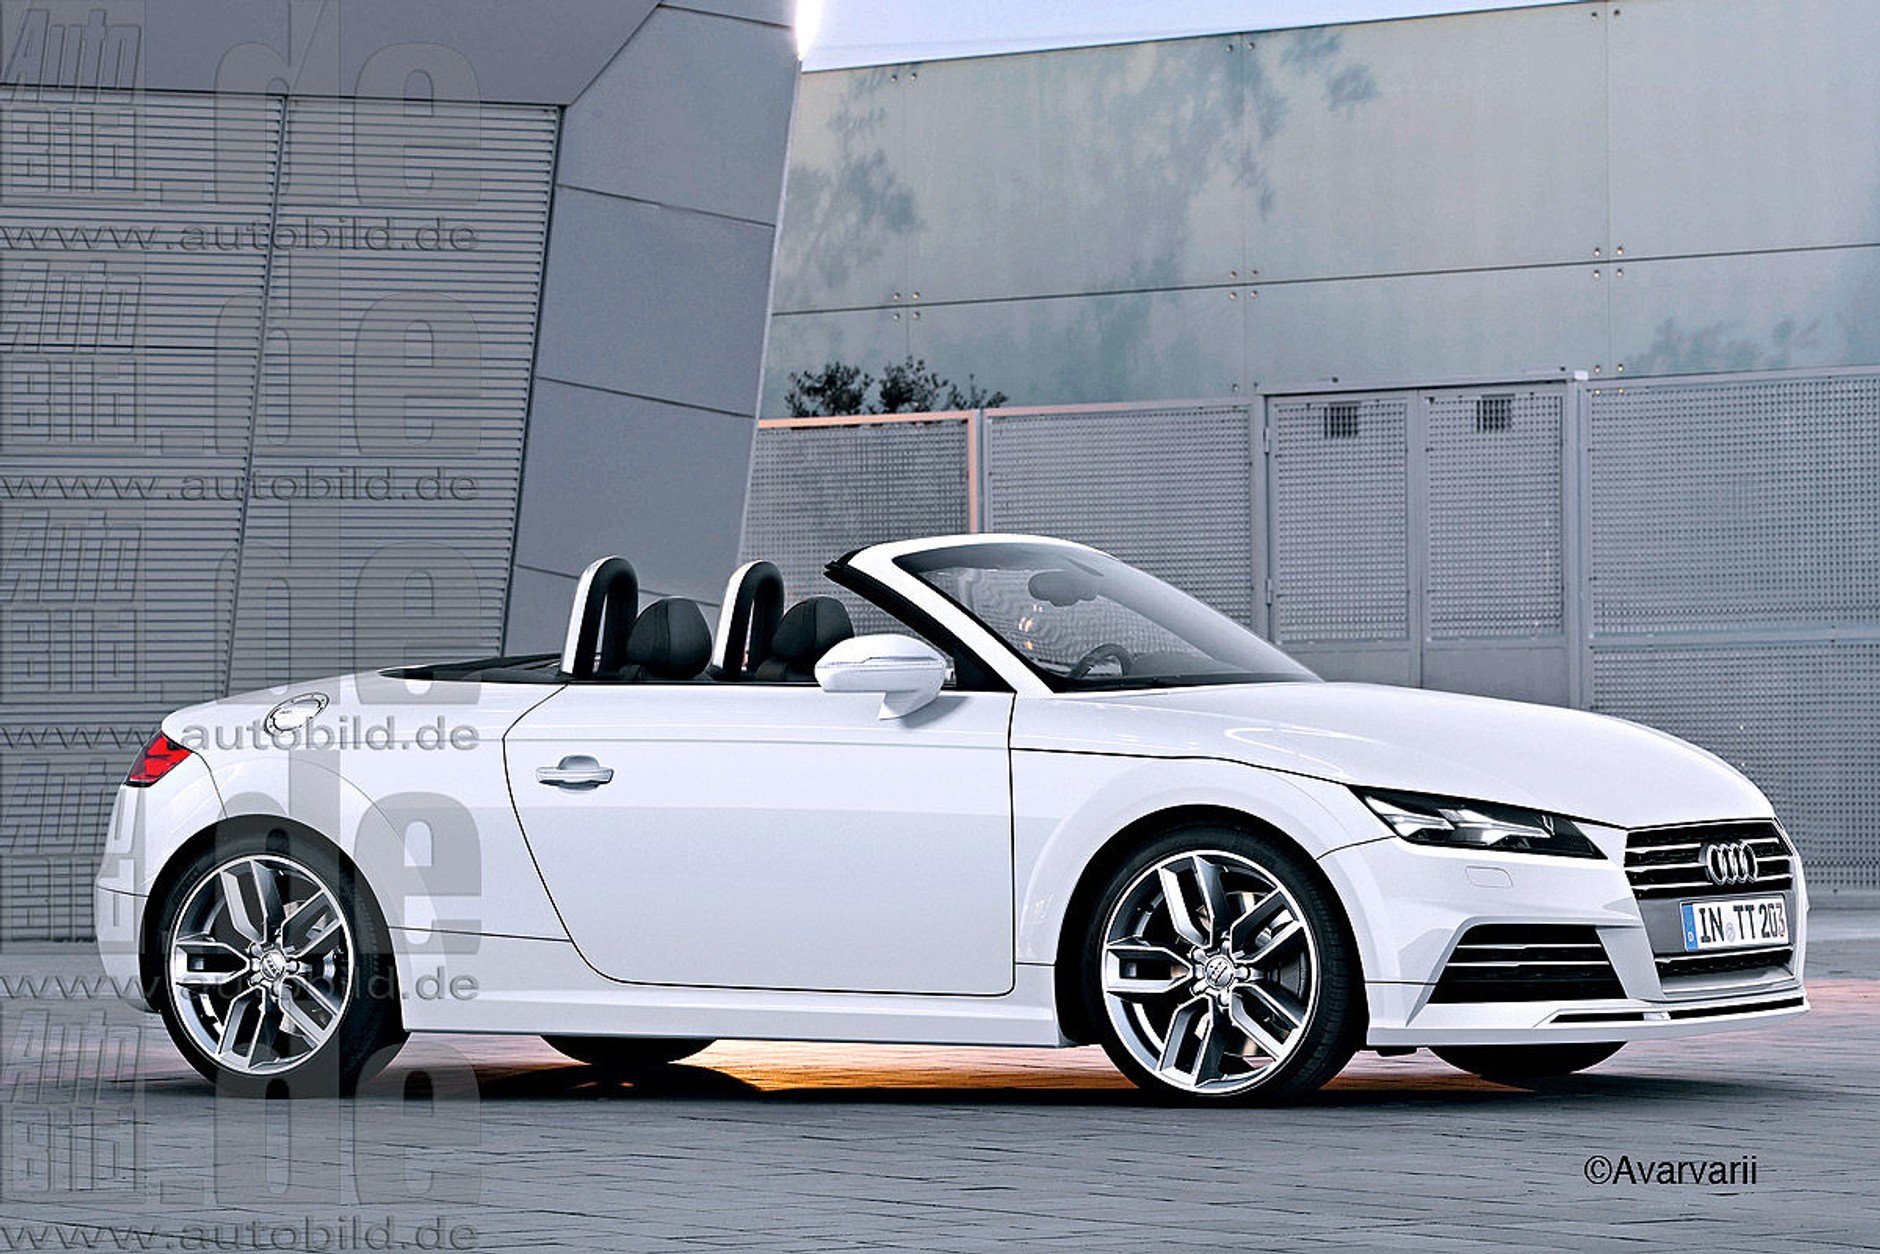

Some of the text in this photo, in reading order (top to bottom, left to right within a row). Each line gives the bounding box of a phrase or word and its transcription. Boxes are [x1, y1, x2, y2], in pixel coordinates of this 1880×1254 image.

[1699, 903, 1786, 943] IN TT 203
